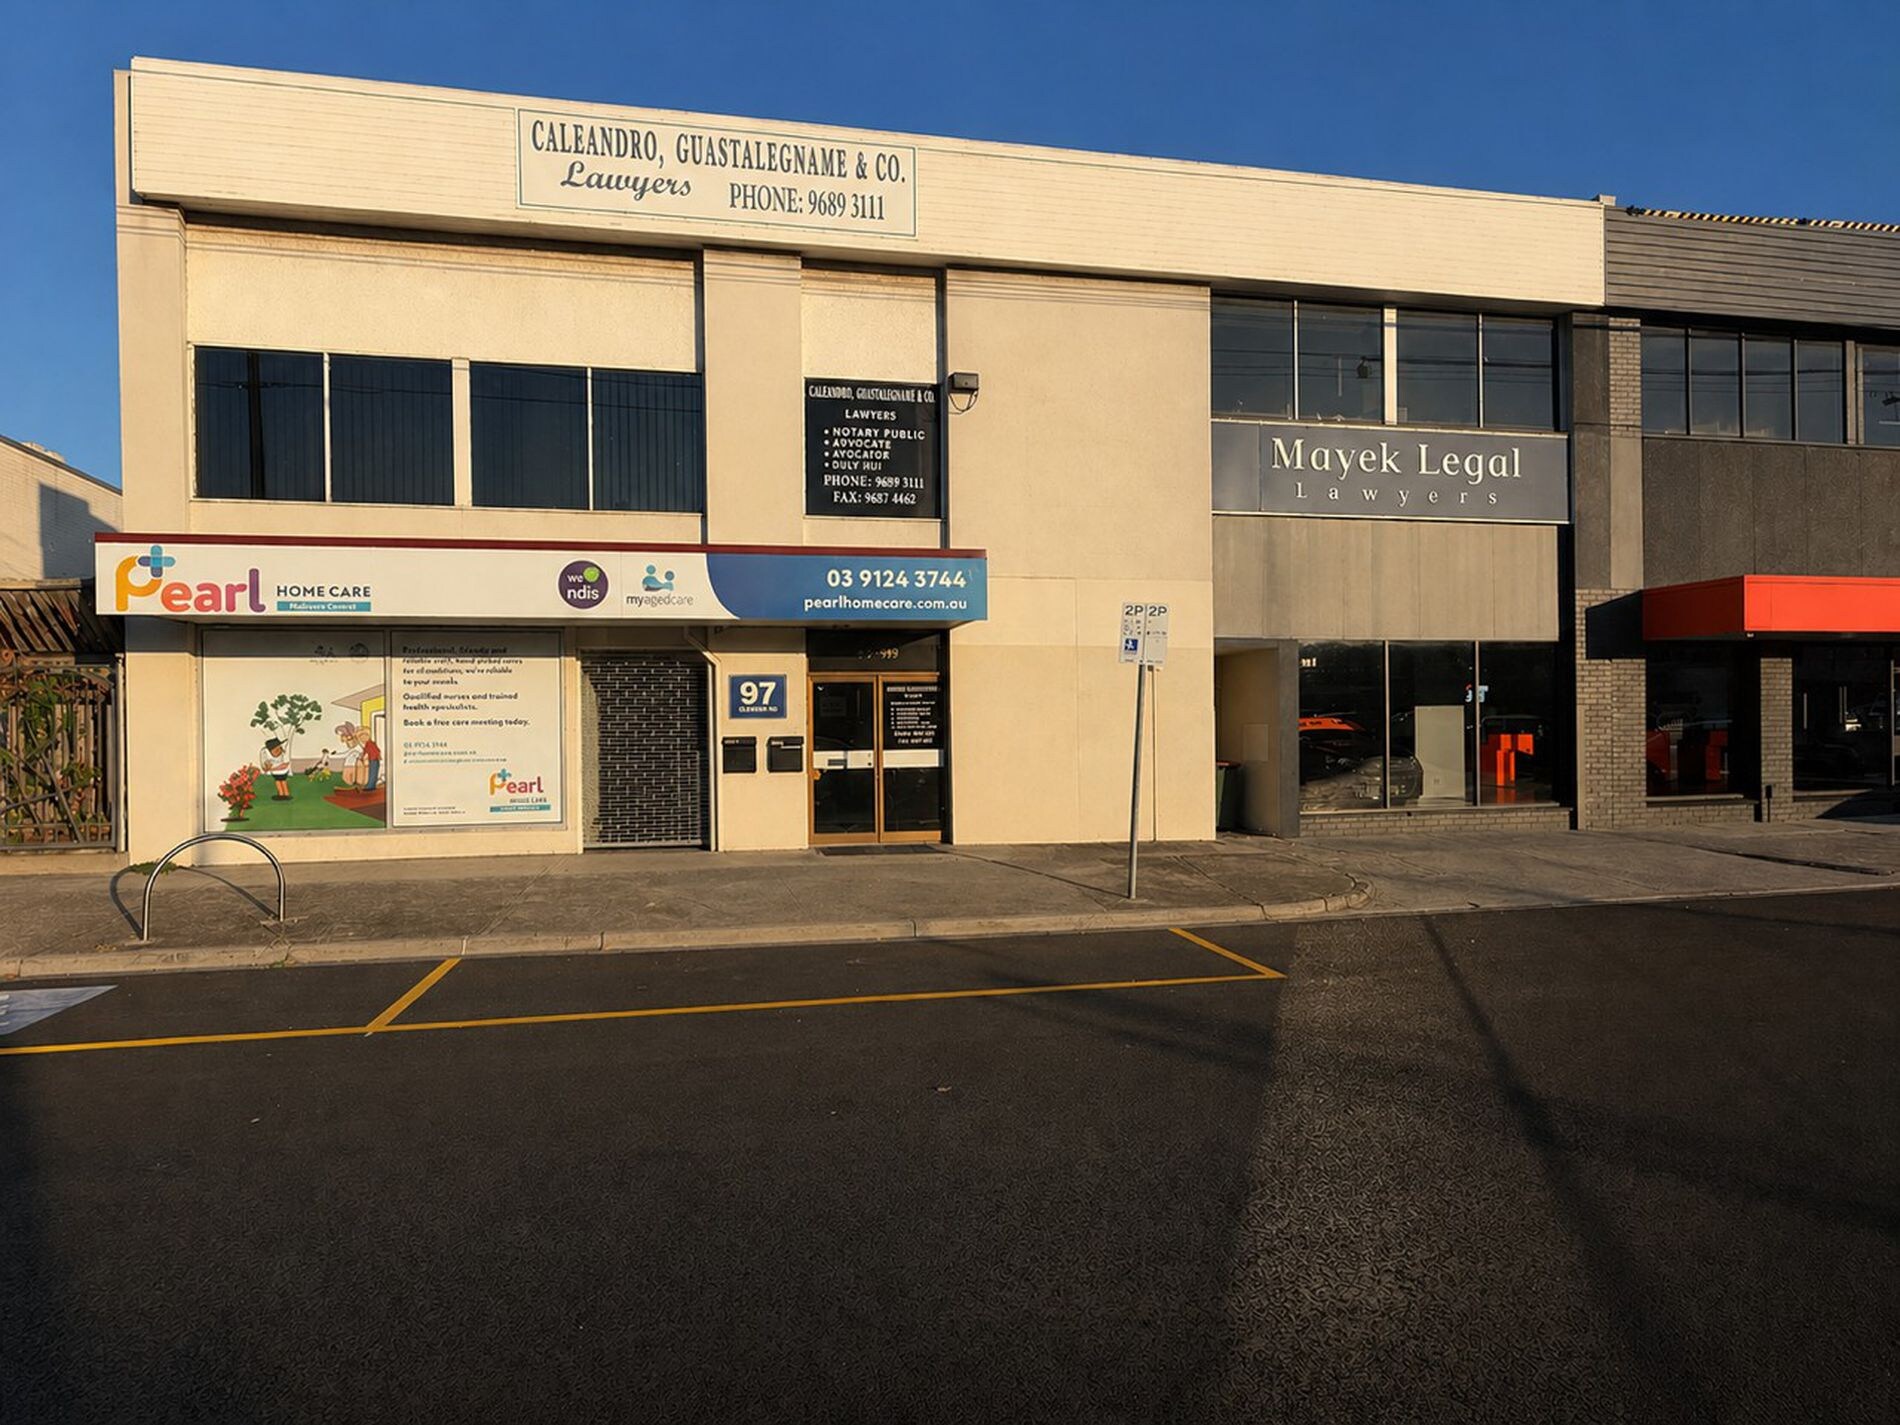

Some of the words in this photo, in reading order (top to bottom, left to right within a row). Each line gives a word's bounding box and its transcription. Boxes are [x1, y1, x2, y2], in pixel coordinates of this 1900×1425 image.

[532, 119, 664, 168] CALEANDRO,
[676, 133, 847, 179] GUASTALEGNAME
[855, 151, 868, 180] &
[875, 152, 906, 183] CO.
[560, 160, 692, 201] Lawyers
[729, 182, 803, 214] PHONE:
[808, 189, 846, 218] 9689
[850, 193, 885, 220] 3111
[845, 409, 897, 421] LAWYERS
[832, 427, 880, 438] NOTARY
[884, 428, 926, 440] PUBLIC
[832, 438, 892, 450] ADVOCATE
[1271, 437, 1401, 481] Mayek
[1418, 443, 1522, 485] Legal
[824, 474, 872, 487] PHONE:
[902, 477, 924, 489] 3111
[833, 490, 861, 503] FAX:
[1296, 482, 1498, 507] Lawyers
[115, 545, 266, 612] Pearl
[567, 573, 583, 583] we
[827, 569, 853, 587] 03
[859, 569, 909, 588] 9124
[914, 570, 967, 588] 3744
[277, 585, 325, 597] HOME
[328, 586, 371, 597] CARE
[567, 584, 600, 600] ndis
[626, 592, 694, 608] myagedcare
[804, 595, 967, 612] pearlhomecare.com.au
[1125, 604, 1143, 616] 2P
[1148, 605, 1167, 617] 2P
[472, 692, 487, 700] and
[740, 681, 776, 706] 97
[403, 719, 424, 727] Book
[434, 718, 449, 727] free
[471, 719, 503, 728] meeting
[505, 718, 531, 728] today.
[489, 768, 543, 796] Pearl
